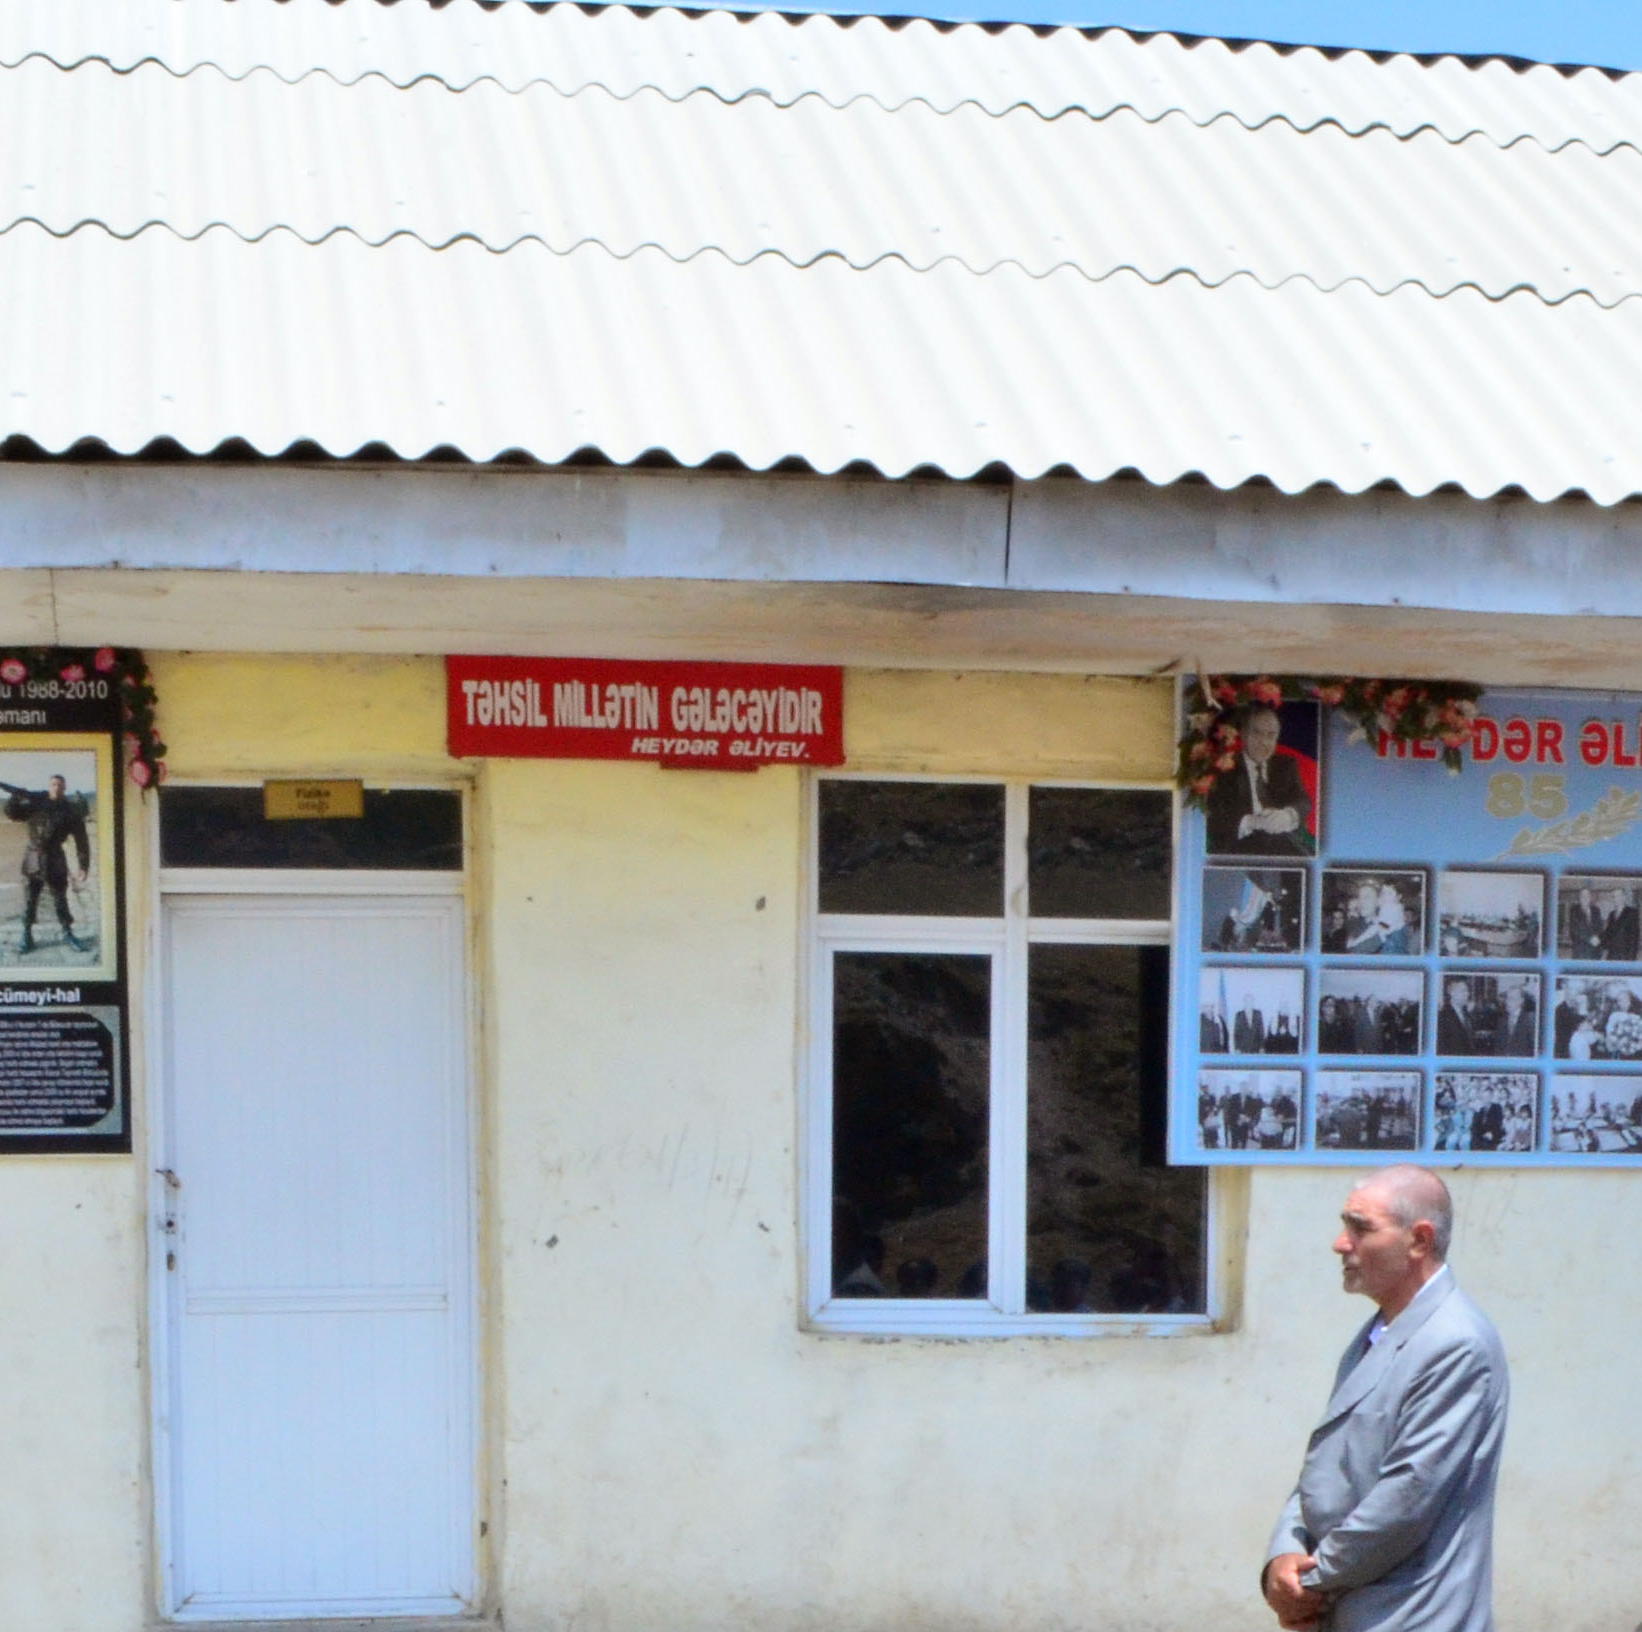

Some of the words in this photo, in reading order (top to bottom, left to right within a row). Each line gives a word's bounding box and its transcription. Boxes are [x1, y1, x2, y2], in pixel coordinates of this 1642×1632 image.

[462, 678, 547, 728] TƏHSİL
[553, 679, 659, 731] MİLLƏTİN
[671, 686, 823, 735] GƏLƏCƏYİDİR
[632, 737, 719, 757] HEYDƏR
[728, 738, 810, 759] ƏLİYEV.
[1376, 716, 1565, 764] HEDƏR
[1484, 771, 1568, 821] 85
